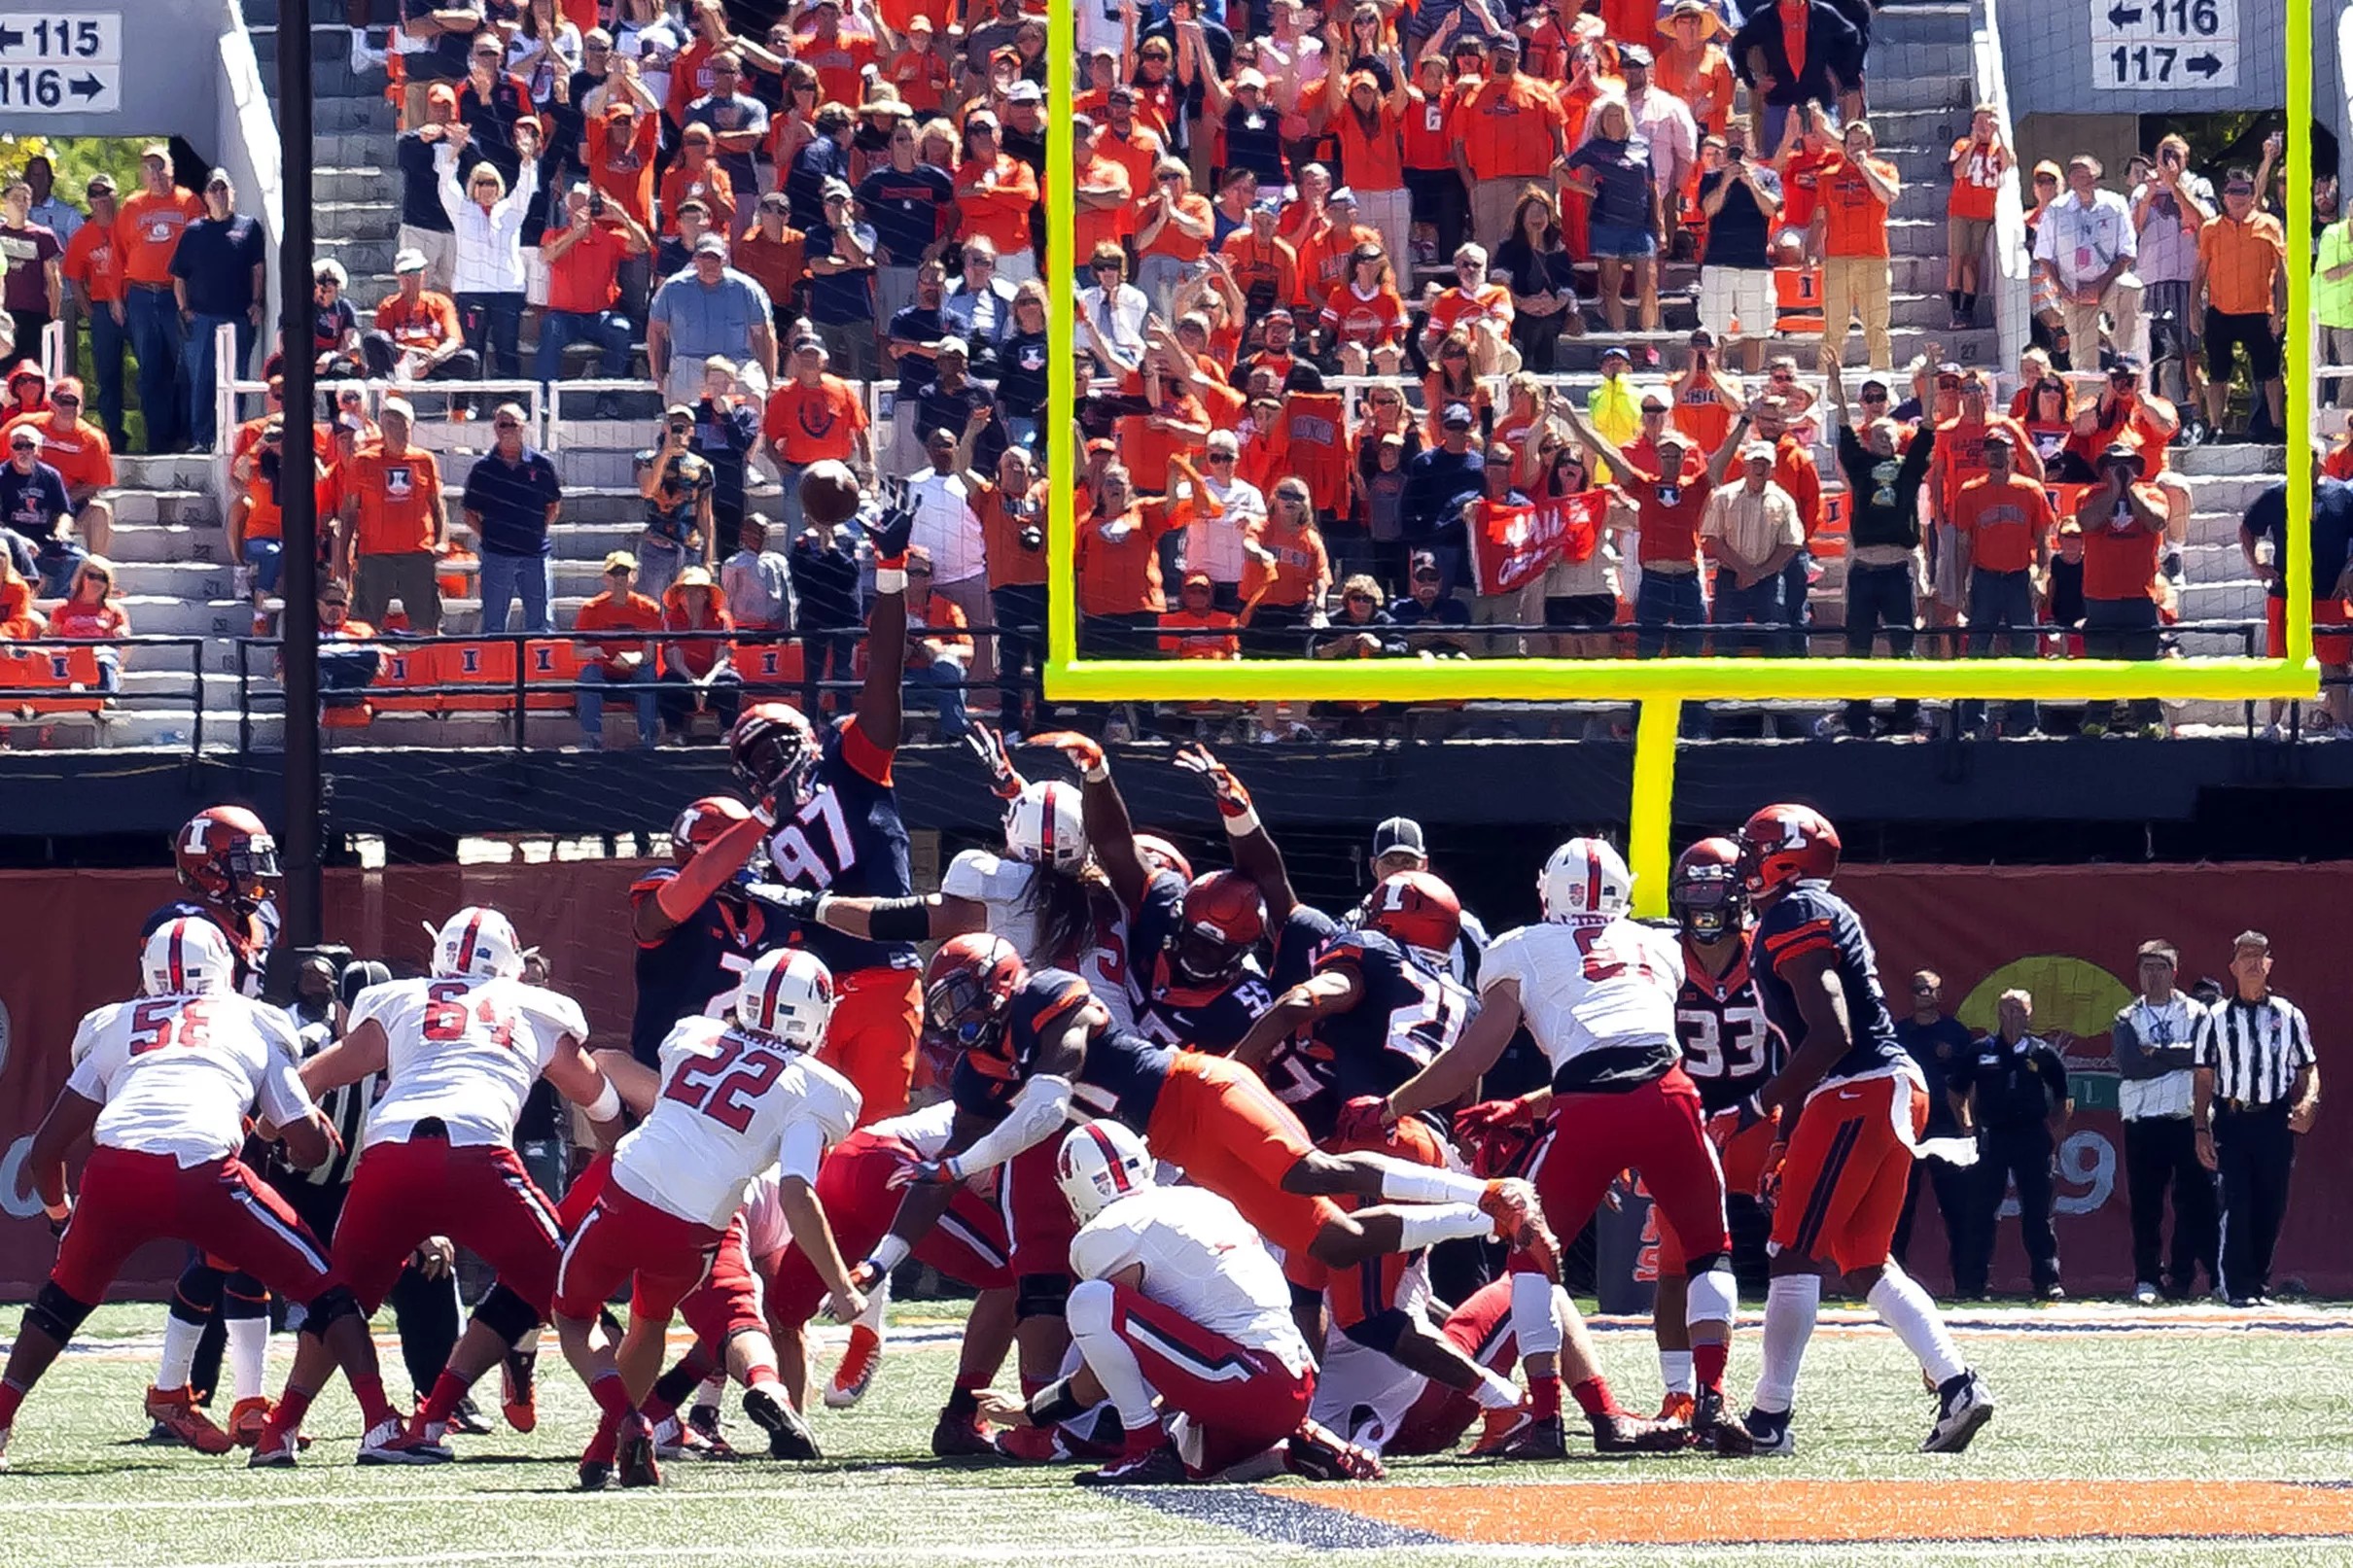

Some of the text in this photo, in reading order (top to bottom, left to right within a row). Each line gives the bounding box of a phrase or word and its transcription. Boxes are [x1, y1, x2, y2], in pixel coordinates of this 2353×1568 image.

[2151, 0, 2219, 36] 116
[32, 19, 99, 57] 115
[2111, 46, 2177, 83] 117
[0, 66, 61, 108] 116
[184, 819, 212, 854] I
[769, 785, 856, 889] 97
[1383, 875, 1410, 911] I
[1677, 1004, 1766, 1077] 33
[663, 1035, 786, 1134] 22
